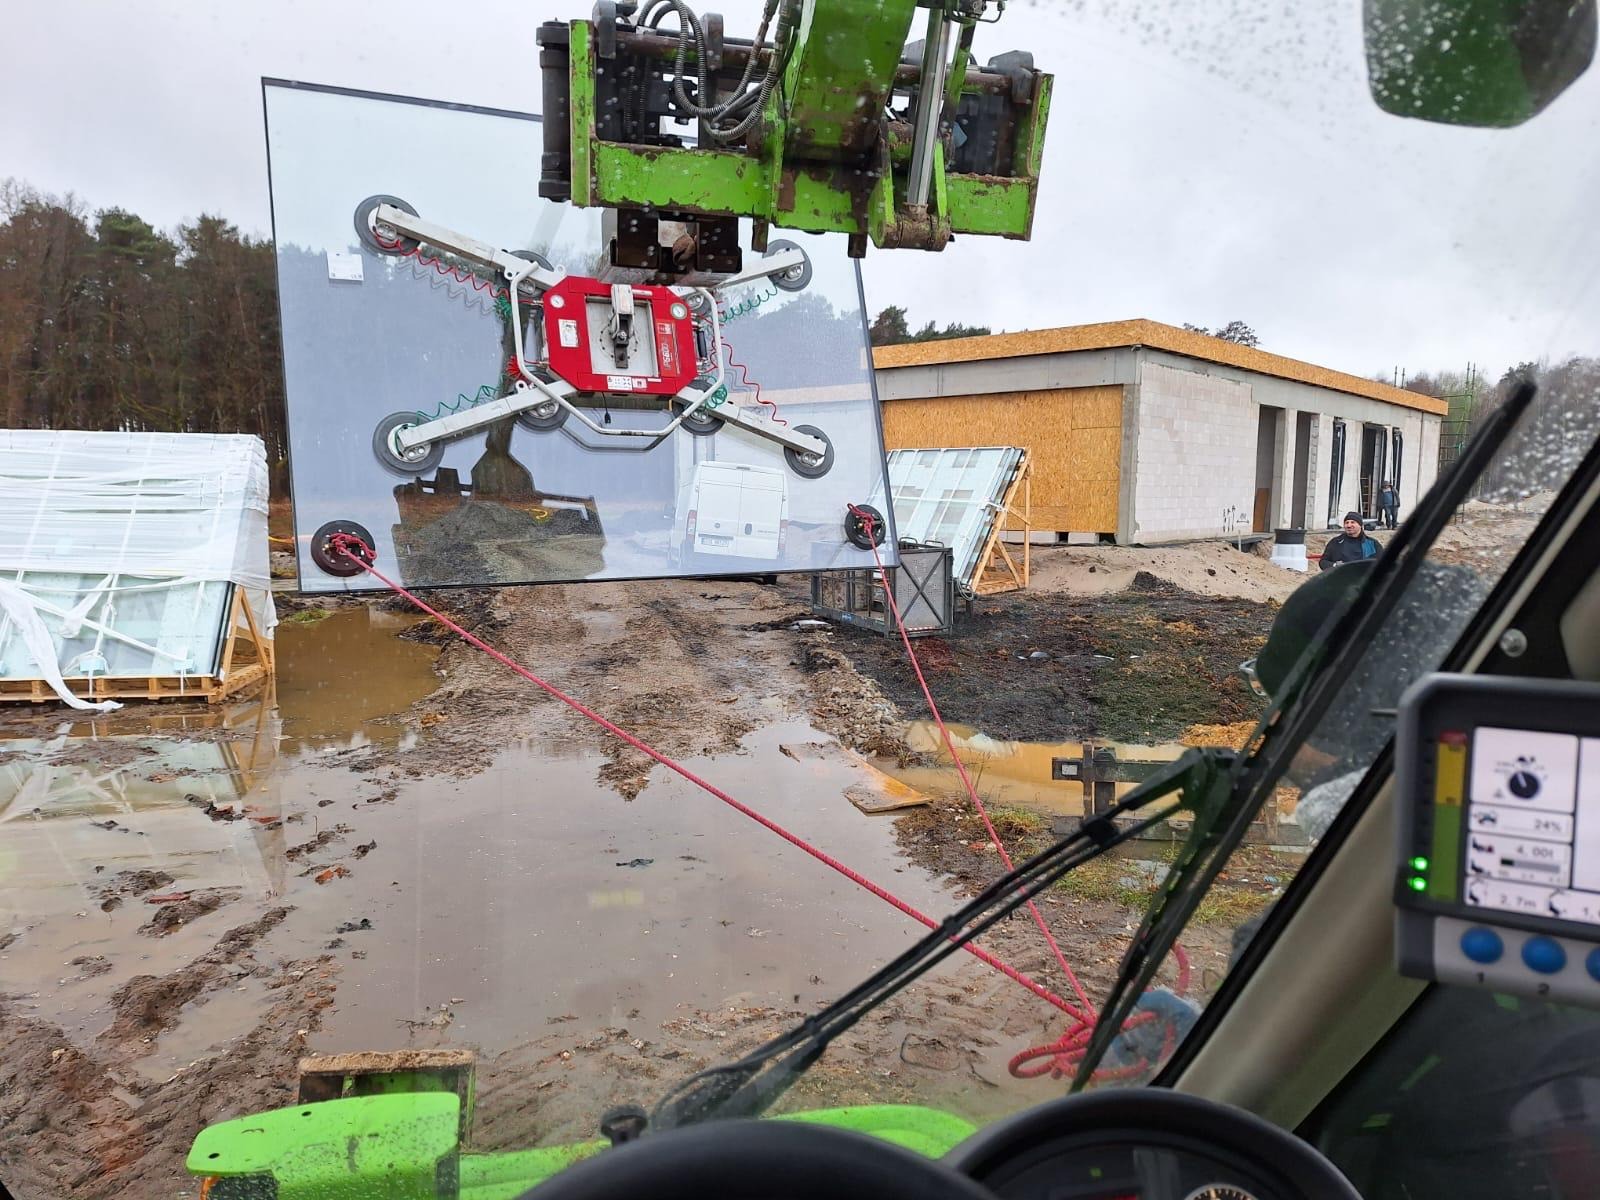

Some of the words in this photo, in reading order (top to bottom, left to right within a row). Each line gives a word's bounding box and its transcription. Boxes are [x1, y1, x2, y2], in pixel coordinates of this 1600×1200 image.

[1535, 819, 1562, 832] 24%
[1477, 971, 1485, 984] 1
[1538, 982, 1550, 994] 2
